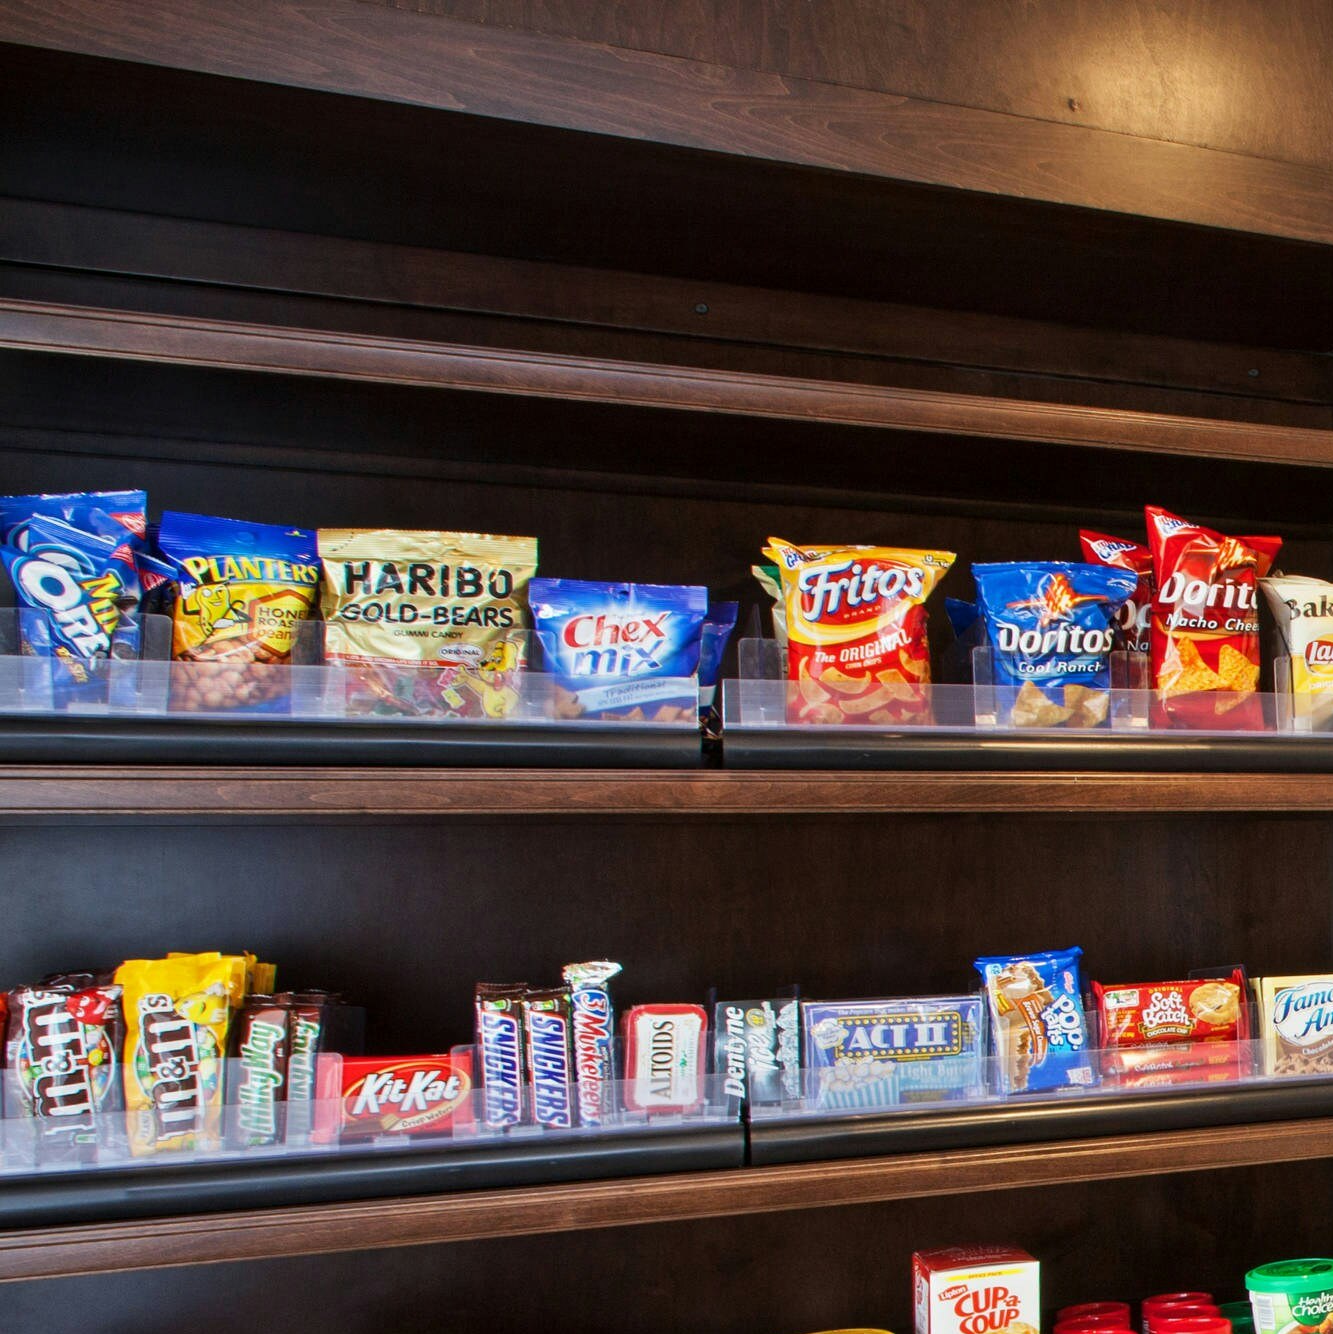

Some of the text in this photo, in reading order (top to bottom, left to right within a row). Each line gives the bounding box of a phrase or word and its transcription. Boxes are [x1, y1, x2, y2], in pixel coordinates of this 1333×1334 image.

[183, 556, 320, 584] PLANTERS
[343, 561, 515, 600] HARIBO
[799, 560, 925, 623] Fritos
[1158, 571, 1259, 610] Dorit
[259, 607, 306, 619] HONE
[340, 602, 515, 629] GOLD-BEARS
[1166, 613, 1218, 631] Nacho
[431, 630, 464, 640] CANDY
[563, 611, 672, 649] Chex
[996, 622, 1115, 654] Doritos
[440, 648, 481, 657] ORIGINAL
[815, 629, 913, 664] The ORIGINAL
[1018, 661, 1105, 674] Cool Ranch
[1151, 991, 1185, 1012] Soft
[1141, 1007, 1191, 1028] Batch
[723, 1006, 746, 1098] Dentyne
[848, 1025, 909, 1051] ACT
[481, 1013, 518, 1126] SNICKERS
[530, 1013, 568, 1129] SNICKERS
[650, 1020, 675, 1100] ALTOIDS
[939, 1285, 968, 1301] Lipton
